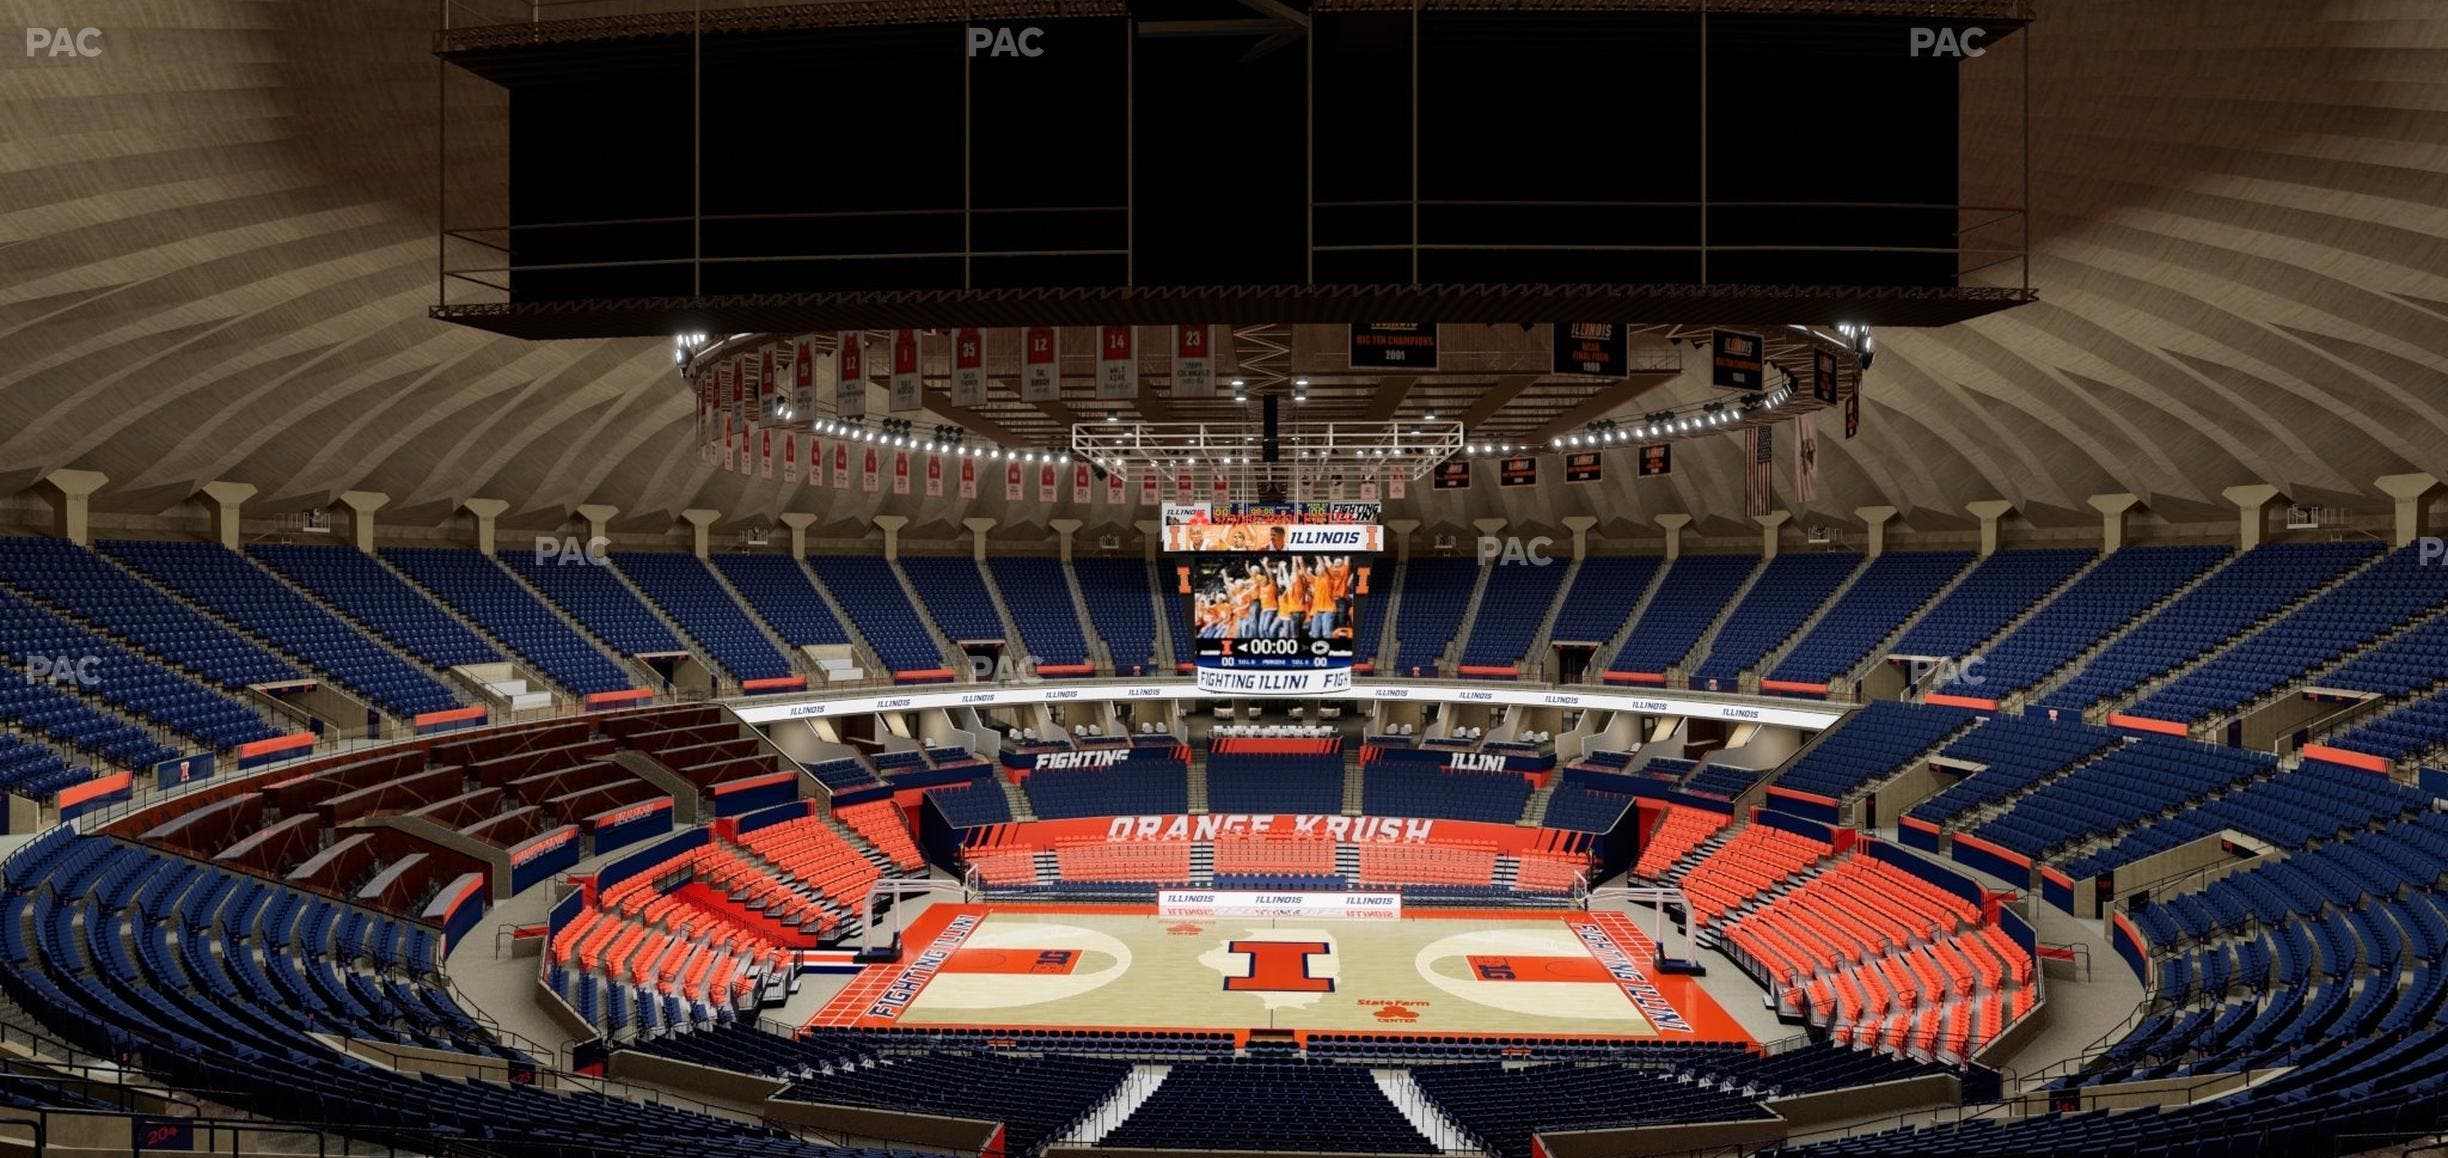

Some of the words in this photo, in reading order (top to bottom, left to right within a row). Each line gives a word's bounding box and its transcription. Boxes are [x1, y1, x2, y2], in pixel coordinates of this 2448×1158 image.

[1186, 331, 1200, 346] 23
[1290, 531, 1360, 544] ILLINOIS
[1250, 639, 1298, 655] 00:00
[1201, 671, 1255, 689] FIGHTING
[1259, 674, 1309, 690] ILLINI
[1045, 690, 1078, 699] ILLINOIS
[1128, 688, 1160, 696] ILLINOIS
[1375, 689, 1408, 697] ILLINOIS
[1458, 691, 1493, 700] ILLINOIS
[877, 698, 911, 708] ILLINOIS
[962, 694, 995, 703] ILLINOIS
[1544, 695, 1580, 704] ILLINOIS
[790, 705, 825, 716] ILLINOIS
[1632, 701, 1668, 711] ILLINOIS
[1722, 708, 1759, 719] ILLINOIS
[1035, 749, 1130, 770] FIGHTING
[1450, 752, 1506, 772] ILLINI
[1107, 815, 1274, 844] ORANGE
[1294, 816, 1435, 845] KRUSH
[1167, 894, 1215, 903] ILLINOIS
[1255, 896, 1303, 904] ILLINOIS
[1345, 896, 1393, 905] ILLINOIS
[867, 950, 949, 1018] FIGHTING
[934, 915, 980, 947] ILLINI
